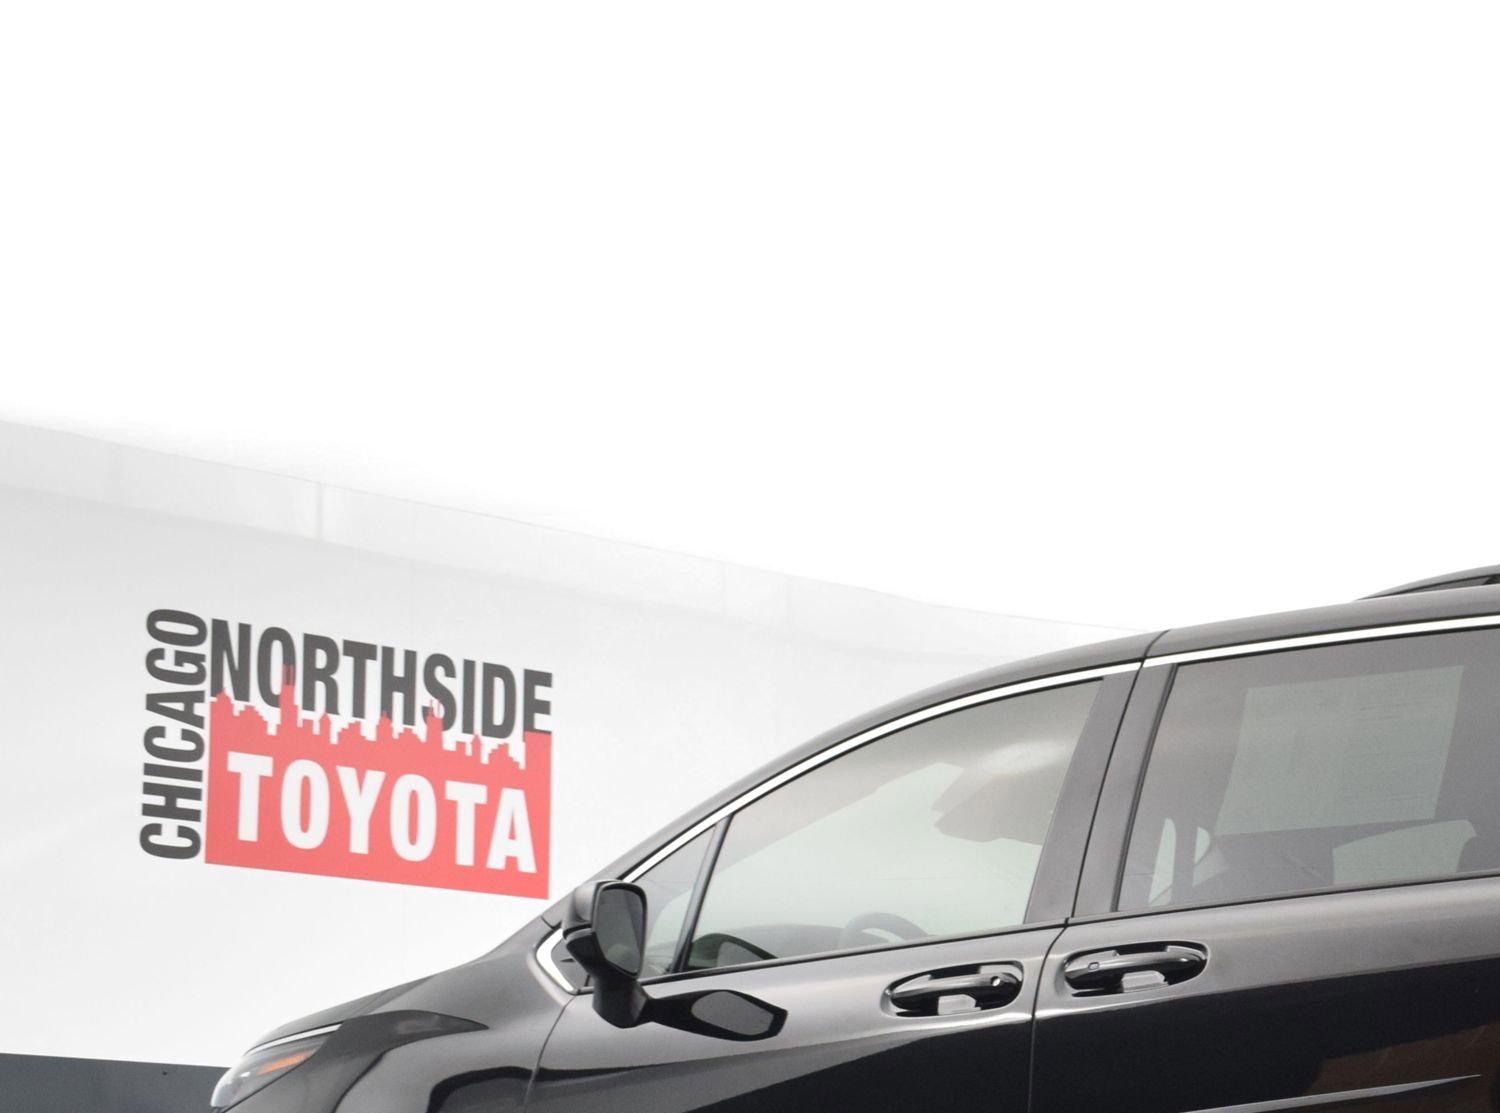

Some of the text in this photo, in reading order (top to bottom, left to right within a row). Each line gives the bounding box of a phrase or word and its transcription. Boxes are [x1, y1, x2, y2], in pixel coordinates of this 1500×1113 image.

[139, 609, 208, 860] CHICAGO
[210, 618, 553, 739] NORTHSIDE
[227, 751, 537, 874] TOYOTA
